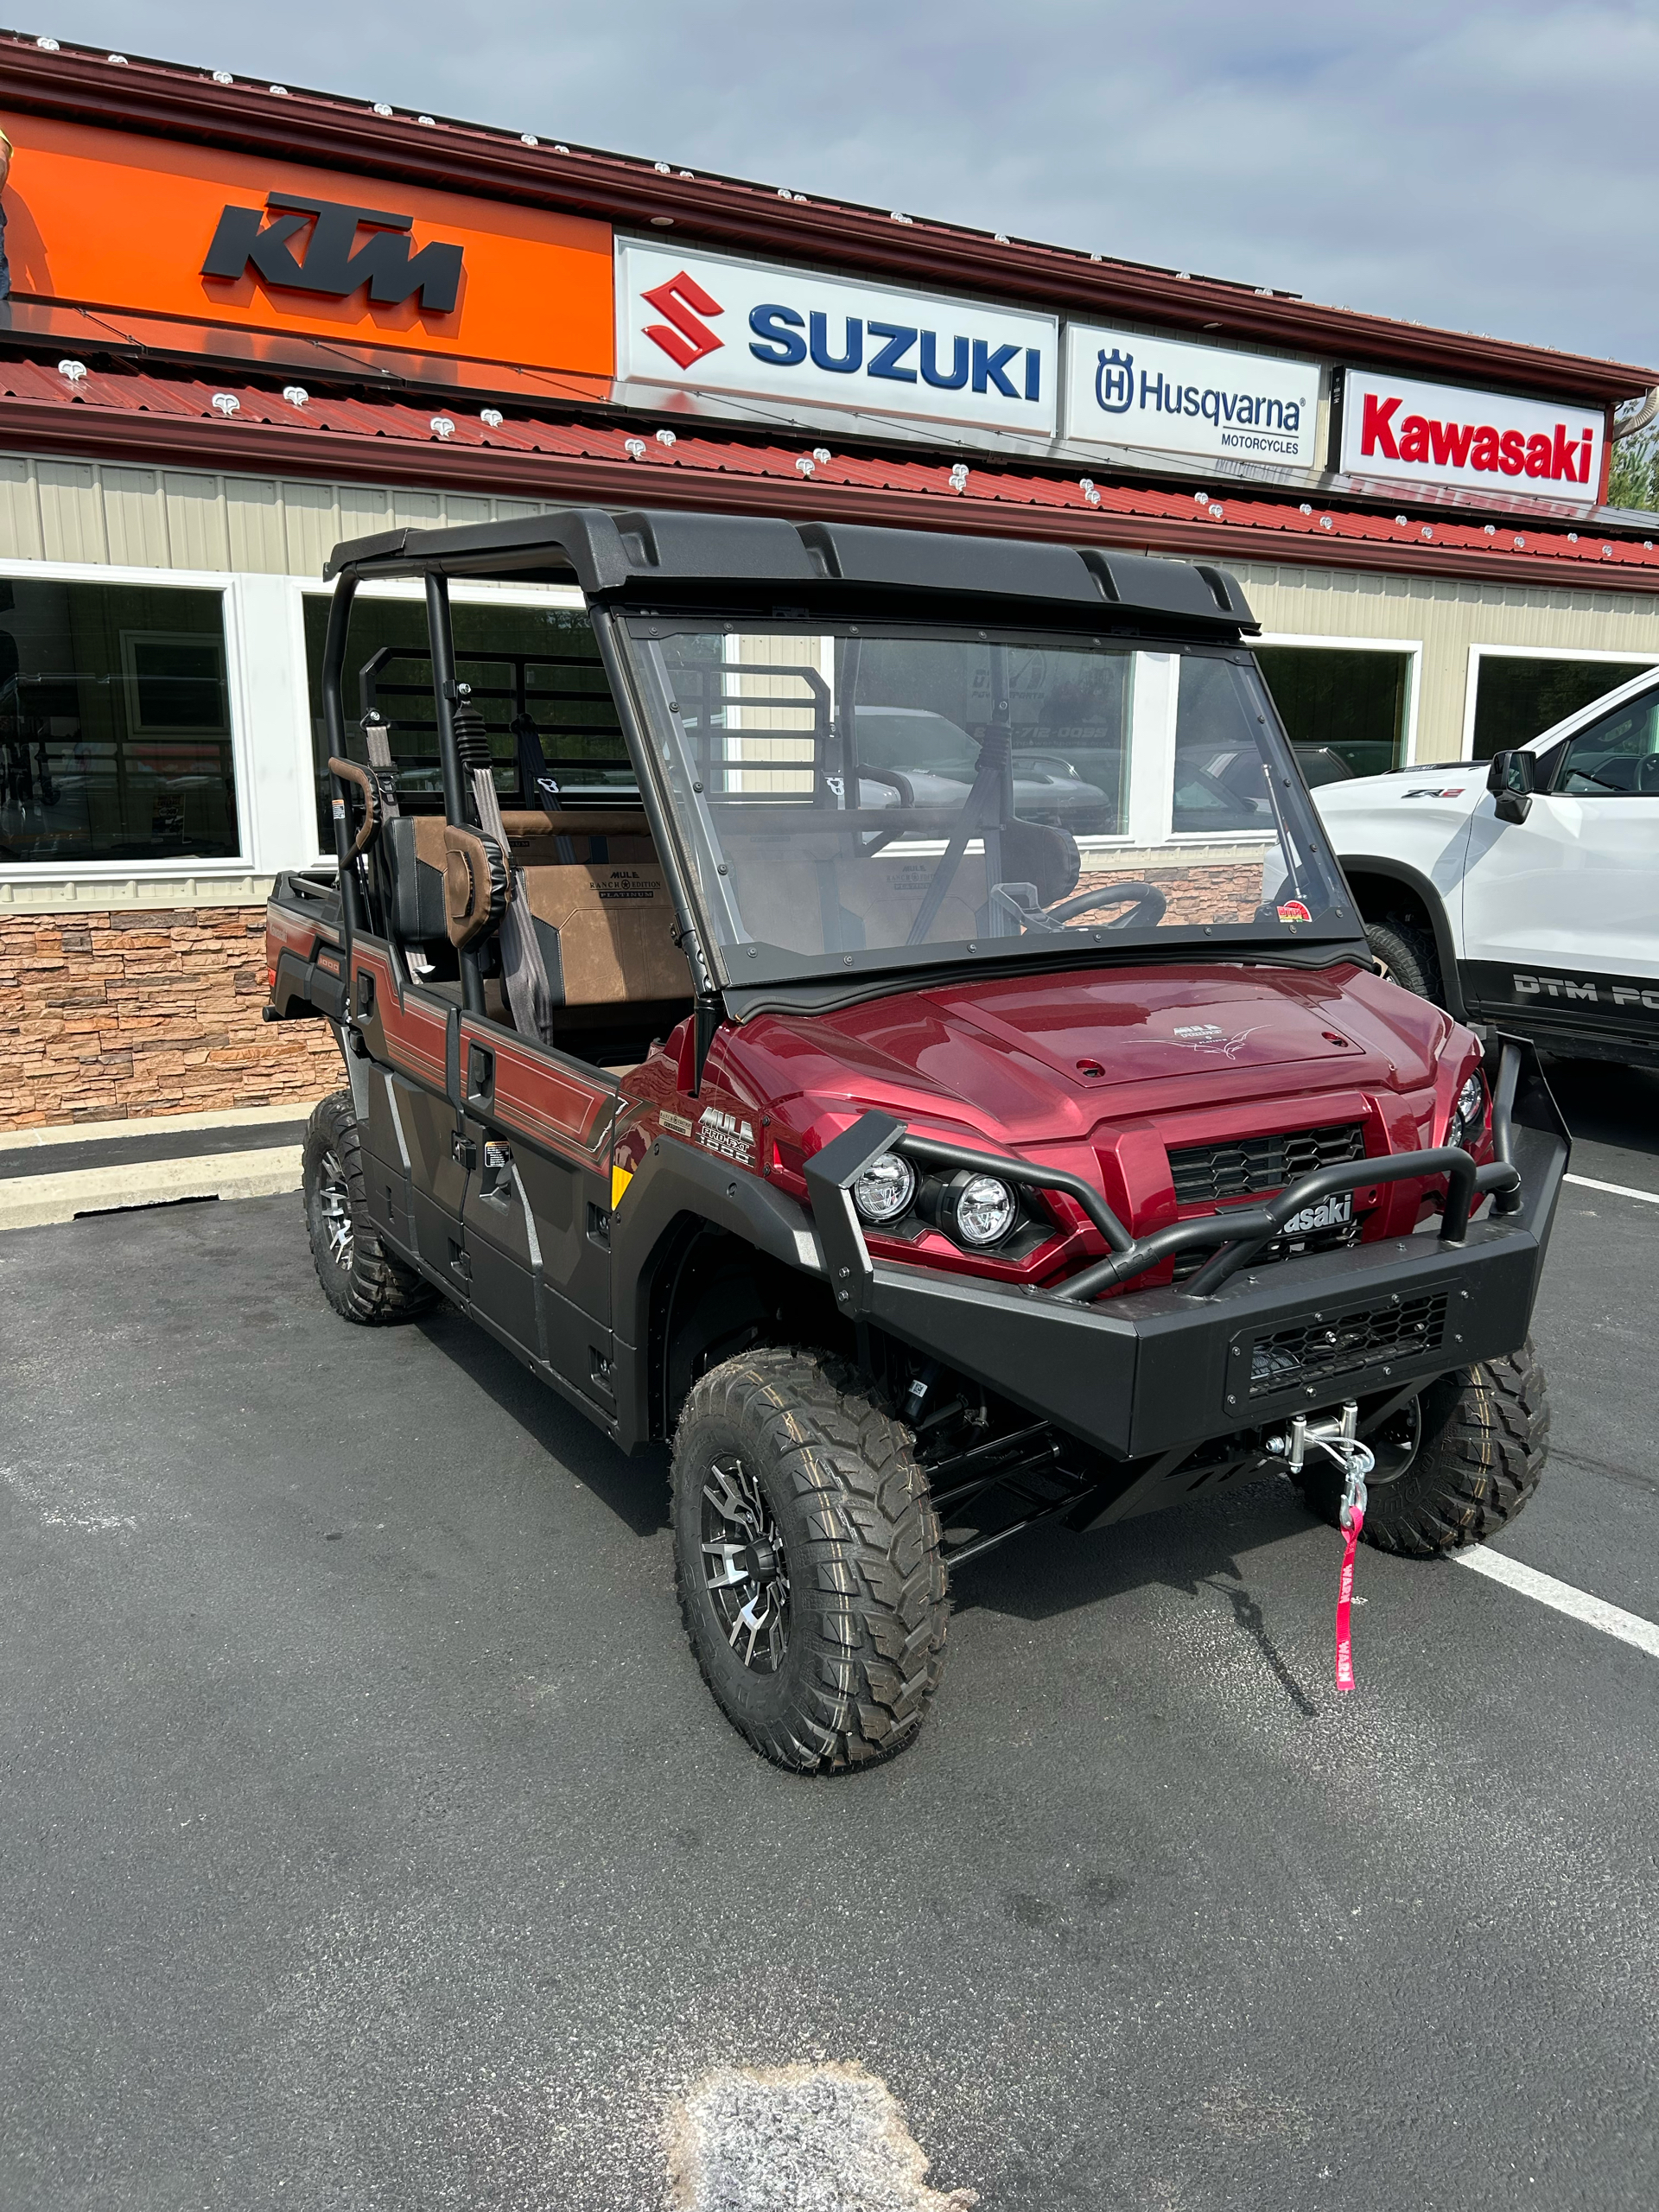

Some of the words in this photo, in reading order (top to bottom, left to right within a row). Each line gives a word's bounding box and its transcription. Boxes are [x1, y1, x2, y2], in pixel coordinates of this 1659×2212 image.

[199, 191, 463, 314] KTM
[748, 303, 1040, 403] SUZUKI
[1140, 370, 1300, 431] Husqvarna
[1221, 433, 1299, 455] MOTORCYCLES
[1361, 393, 1593, 484] Kawasaki
[974, 727, 1109, 739] 8-712-0099
[1401, 788, 1466, 799] ZR2
[318, 957, 340, 971] 1000
[1513, 974, 1599, 1002] DTM
[698, 1106, 756, 1147] MULE
[700, 1135, 749, 1164] 1000
[1283, 1194, 1351, 1233] asaki
[1338, 1563, 1353, 1604] WARN
[1338, 1640, 1351, 1682] WARN
